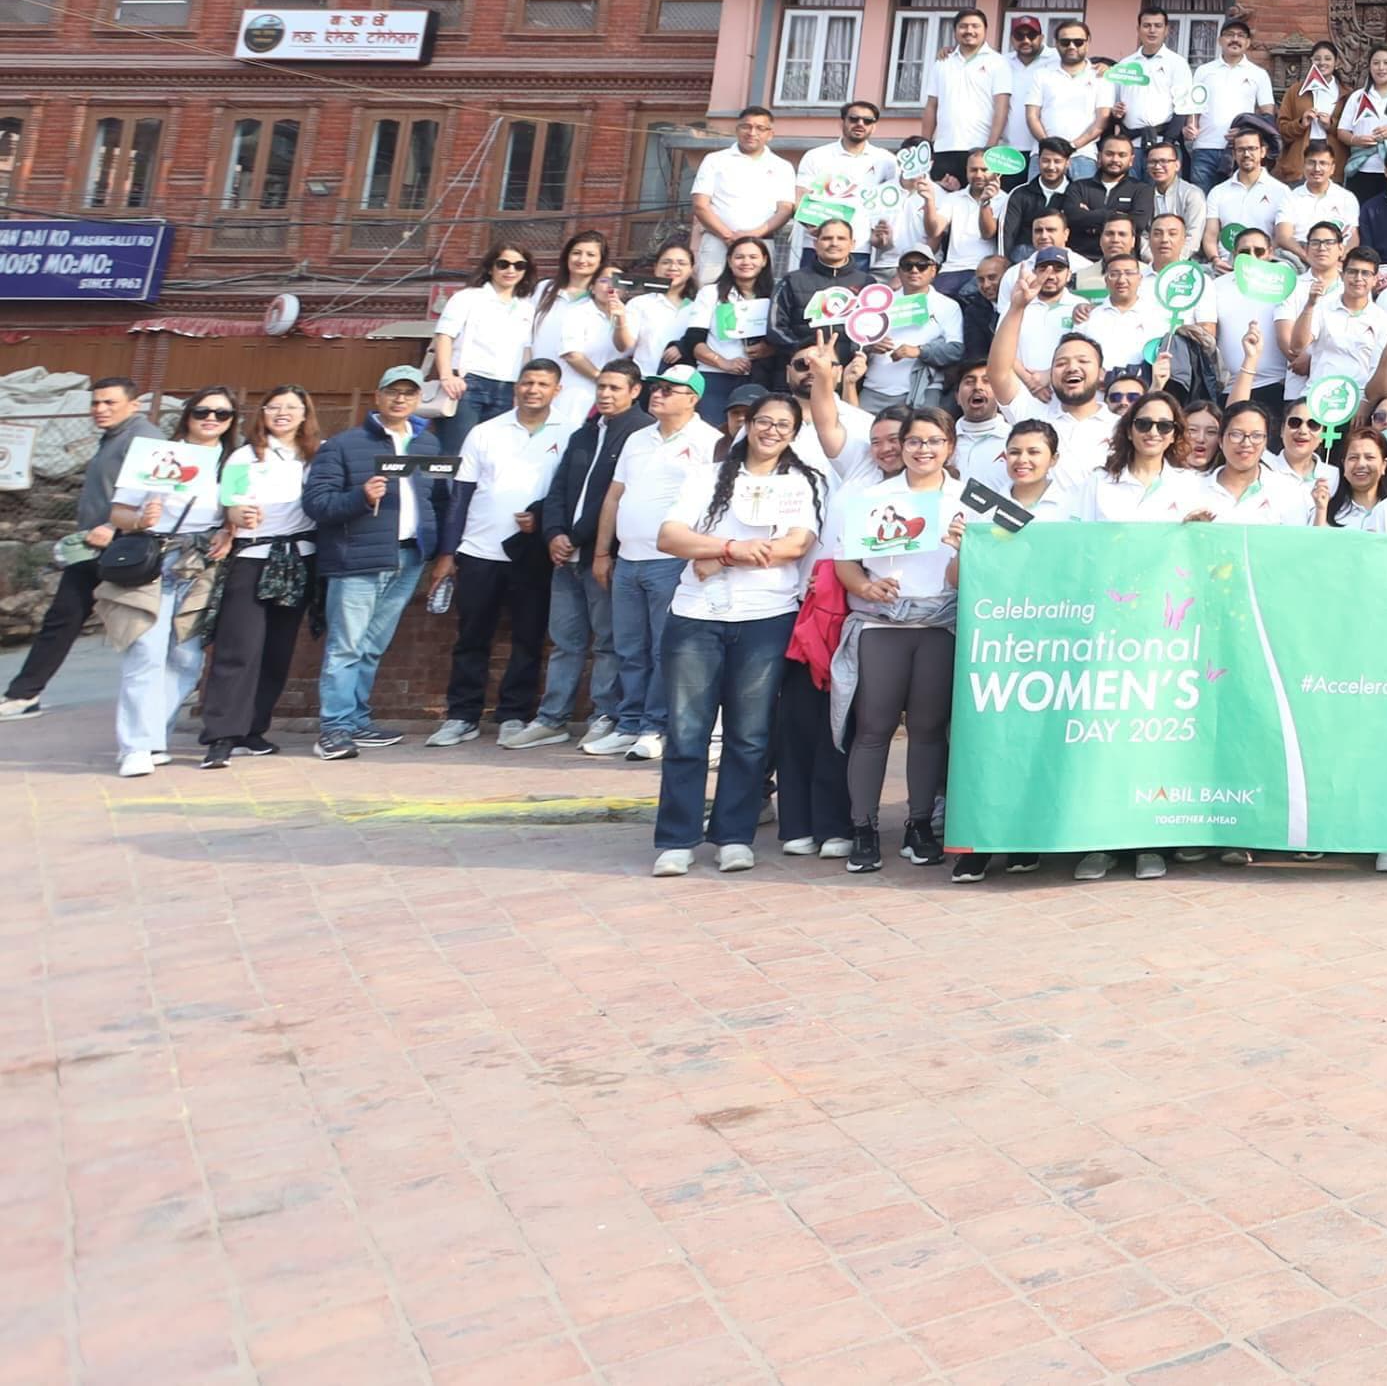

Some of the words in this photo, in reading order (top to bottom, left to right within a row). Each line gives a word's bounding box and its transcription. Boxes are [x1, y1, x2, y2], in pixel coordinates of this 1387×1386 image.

[19, 229, 48, 246] DAI
[48, 230, 70, 246] KO
[78, 278, 114, 289] SINCE
[847, 285, 893, 343] 8
[381, 464, 406, 472] LADY
[974, 599, 1095, 622] Celebrating
[970, 626, 1200, 663] International
[969, 670, 1200, 712] WOMEN'S
[1065, 719, 1119, 744] DAY
[1130, 718, 1196, 742] 2025
[1135, 787, 1195, 804] NABIL
[1200, 787, 1255, 804] BANK
[1155, 815, 1204, 824] TOGETHER
[1205, 815, 1237, 824] AHEAD
